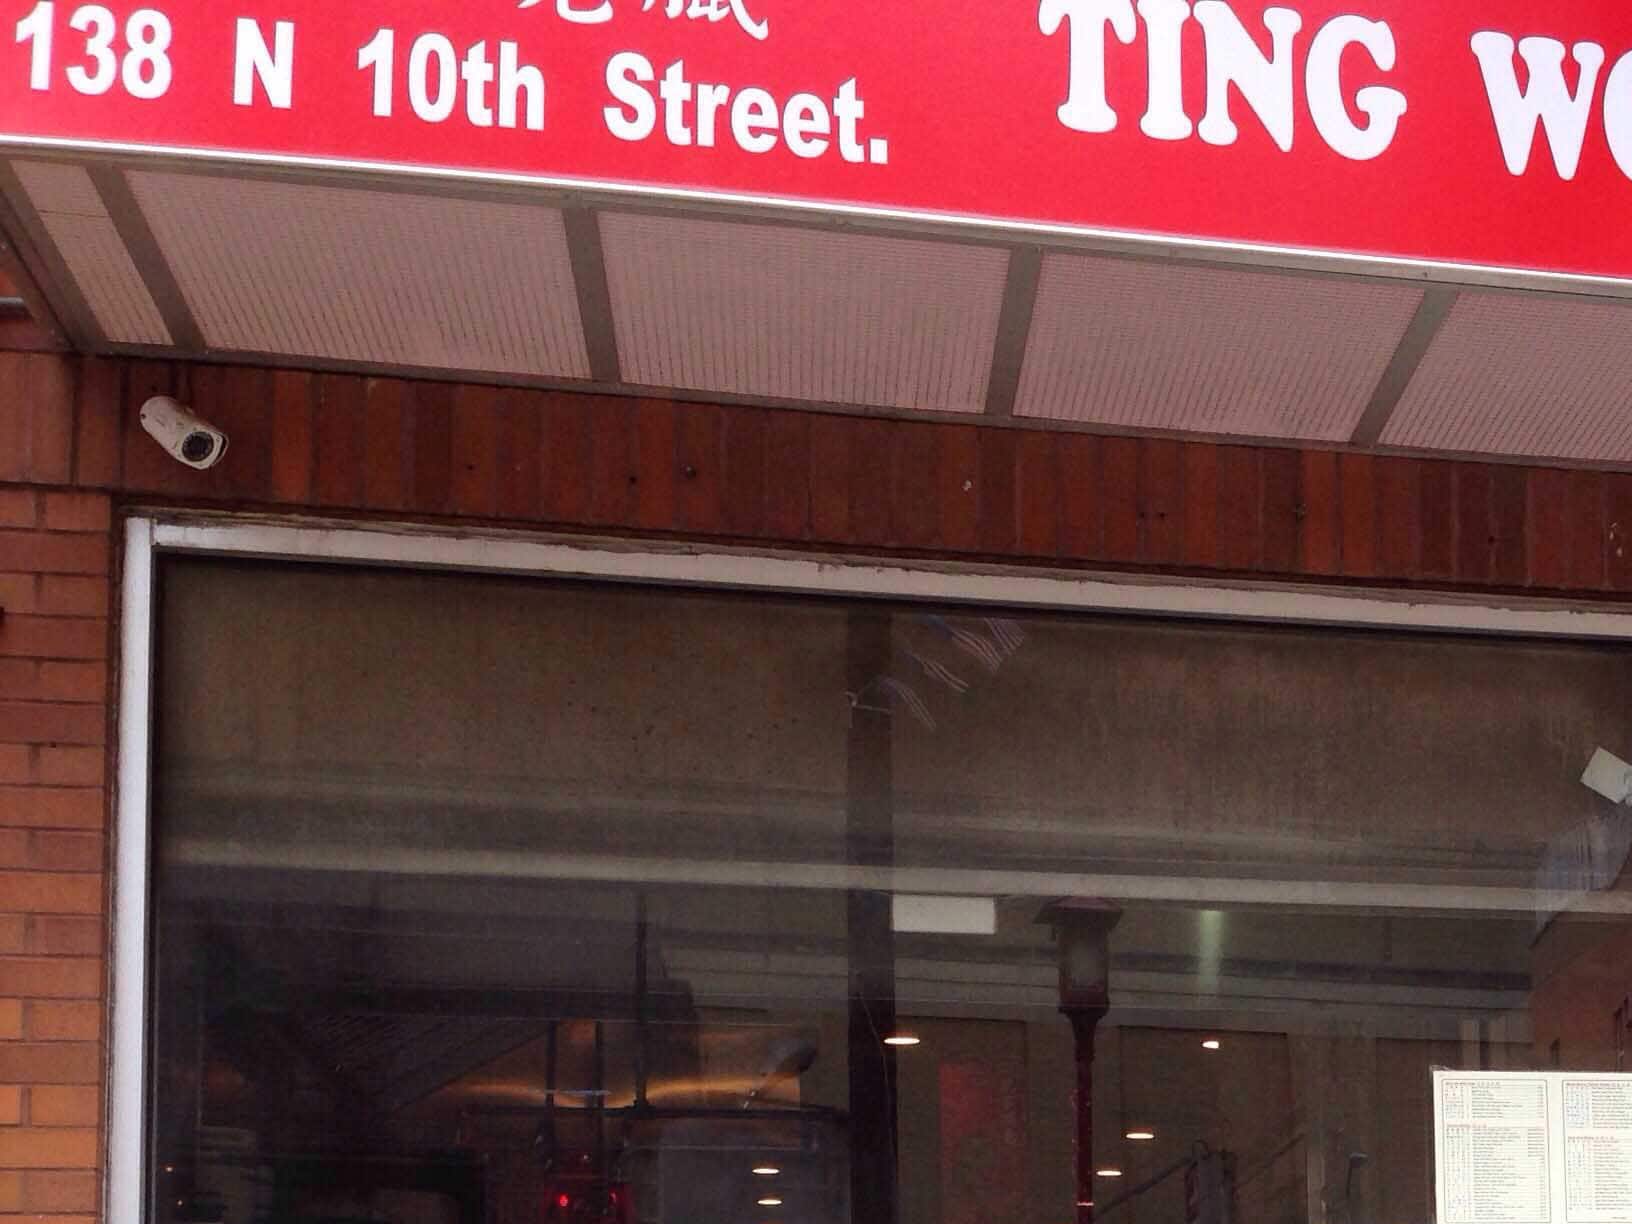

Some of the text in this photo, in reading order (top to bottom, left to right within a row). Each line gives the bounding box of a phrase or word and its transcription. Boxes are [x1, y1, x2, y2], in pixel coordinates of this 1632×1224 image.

[15, 1, 889, 164] 138 N 10th Street.
[1037, 0, 1408, 161] TING
